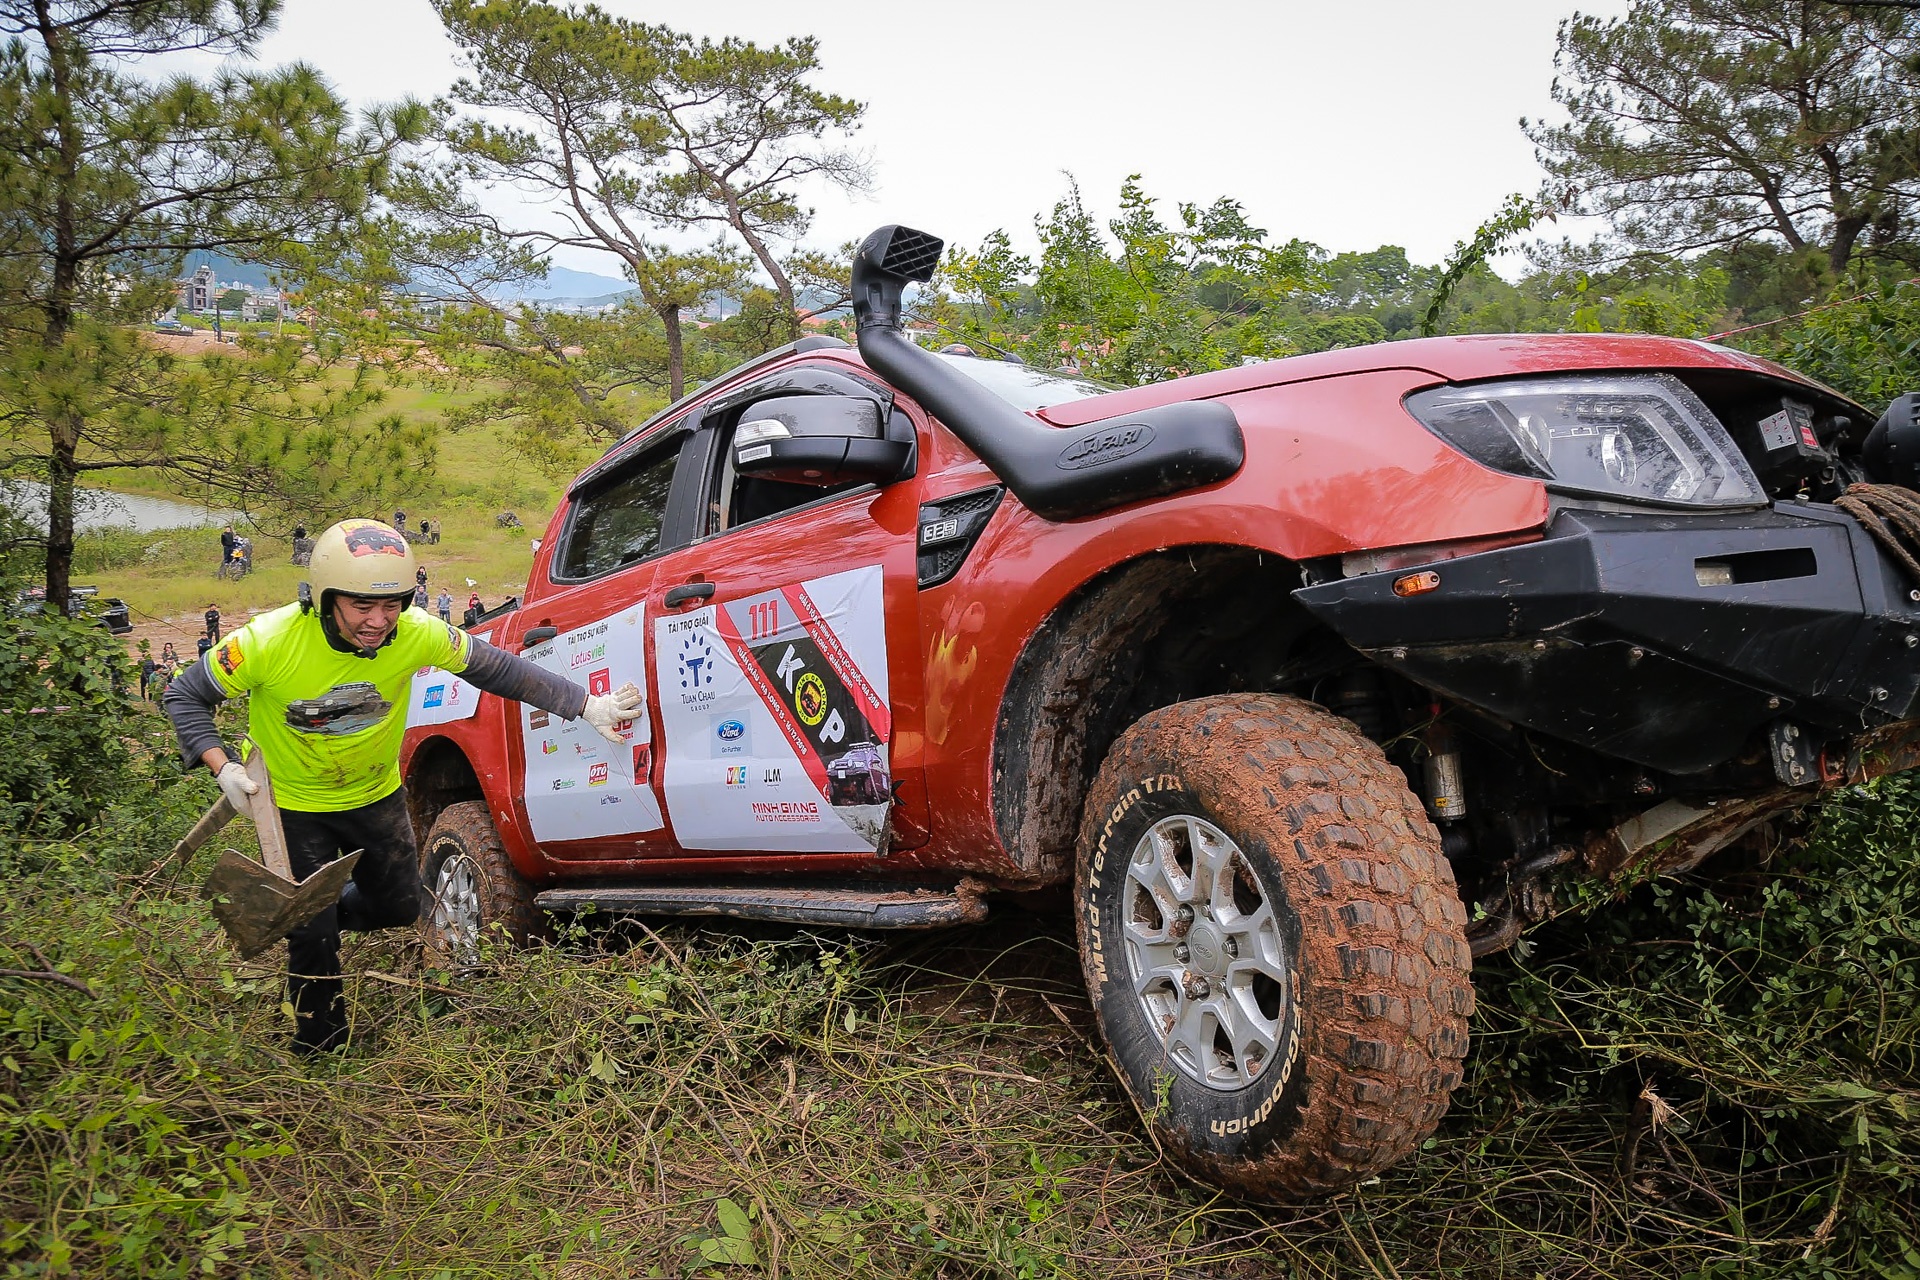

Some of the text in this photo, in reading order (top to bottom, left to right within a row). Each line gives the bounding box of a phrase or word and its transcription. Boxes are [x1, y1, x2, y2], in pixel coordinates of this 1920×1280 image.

[1067, 428, 1143, 461] SAFARI
[748, 599, 778, 641] 111
[767, 693, 780, 712] LONG
[721, 723, 740, 738] Ford
[763, 768, 782, 783] JLM
[752, 802, 818, 814] MINH GIANG
[774, 814, 821, 822] ACCESSORIES
